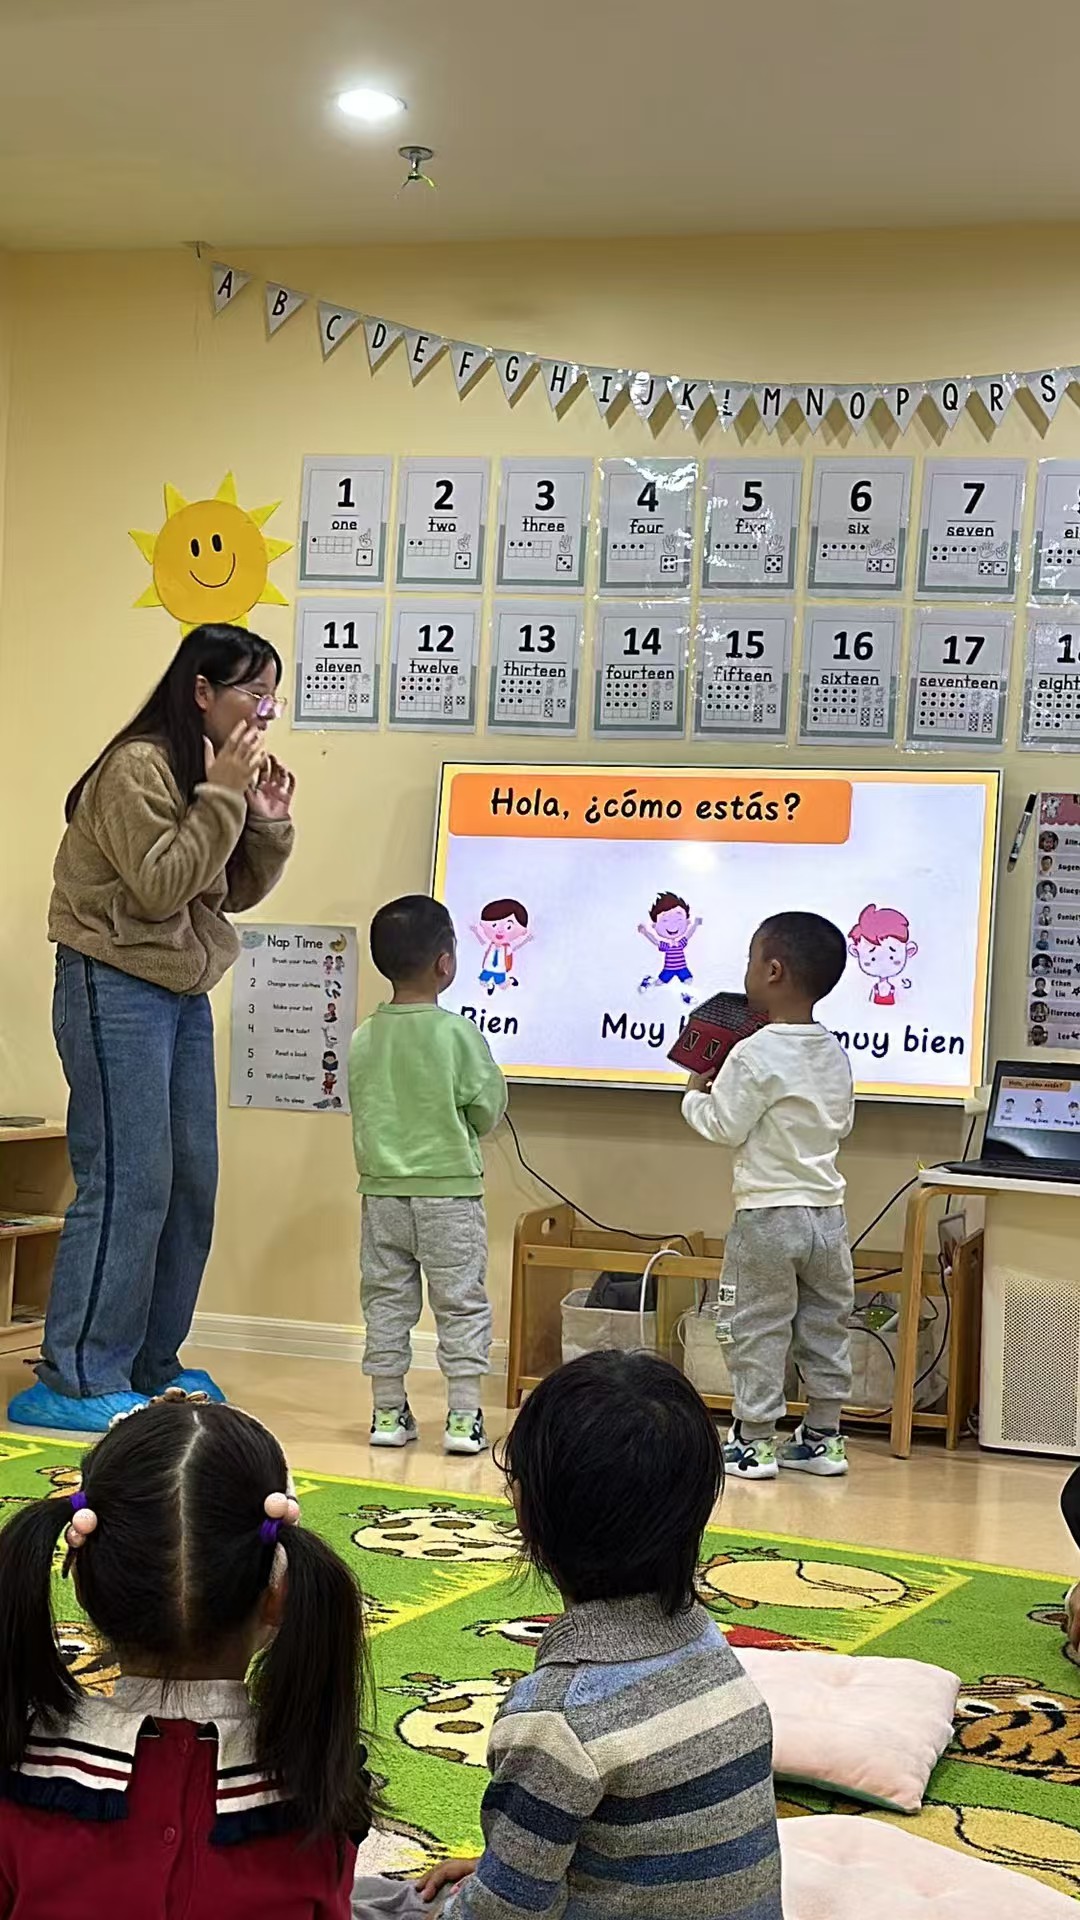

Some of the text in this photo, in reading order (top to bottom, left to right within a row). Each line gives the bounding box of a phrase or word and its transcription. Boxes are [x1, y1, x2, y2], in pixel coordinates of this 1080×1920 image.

[217, 270, 234, 299] A
[272, 290, 288, 316] B
[326, 314, 342, 341] C
[371, 323, 387, 349] D
[413, 336, 429, 363] E
[458, 352, 474, 378] F
[505, 355, 520, 382] G
[550, 366, 568, 393] H
[599, 375, 613, 403] I
[640, 379, 655, 406] J
[680, 383, 698, 410] K
[763, 388, 781, 416] M
[806, 388, 824, 415] N
[849, 392, 866, 420] O
[896, 388, 909, 415] P
[943, 383, 959, 410] Q
[990, 383, 1004, 411] R
[1041, 374, 1056, 402] S
[337, 478, 356, 508] 1
[434, 479, 454, 511] 2
[534, 479, 556, 511] 3
[636, 481, 659, 512] 4
[742, 481, 763, 512] 5
[850, 480, 872, 512] 6
[962, 482, 986, 514] 7
[332, 519, 357, 530] one
[428, 518, 457, 532] two
[522, 517, 565, 532] three
[629, 518, 664, 534] four
[848, 521, 870, 534] six
[946, 525, 994, 537] seven
[323, 621, 359, 649] 11
[417, 624, 455, 652] 12
[518, 624, 557, 653] 13
[623, 627, 662, 655] 14
[725, 630, 765, 659] 15
[832, 631, 874, 660] 16
[942, 635, 986, 665] 17
[1056, 634, 1080, 663] 1
[315, 658, 362, 673] eleven
[409, 659, 459, 674] twelve
[503, 661, 566, 677] thirteen
[606, 664, 675, 680] fourteen
[714, 667, 772, 682] fifteen
[821, 671, 880, 685] sixteen
[919, 675, 999, 689] seventeen
[490, 787, 802, 824] Hola, ¿cómo estás?
[267, 934, 323, 950] Nap Time
[250, 977, 256, 988] 2
[248, 1003, 255, 1014] 3
[461, 1005, 518, 1034] Bien
[248, 1023, 255, 1033] 4
[602, 1012, 665, 1048] Muy
[247, 1047, 254, 1058] 5
[829, 1025, 964, 1058] muy bien
[247, 1067, 254, 1078] 6
[246, 1094, 252, 1105] 7
